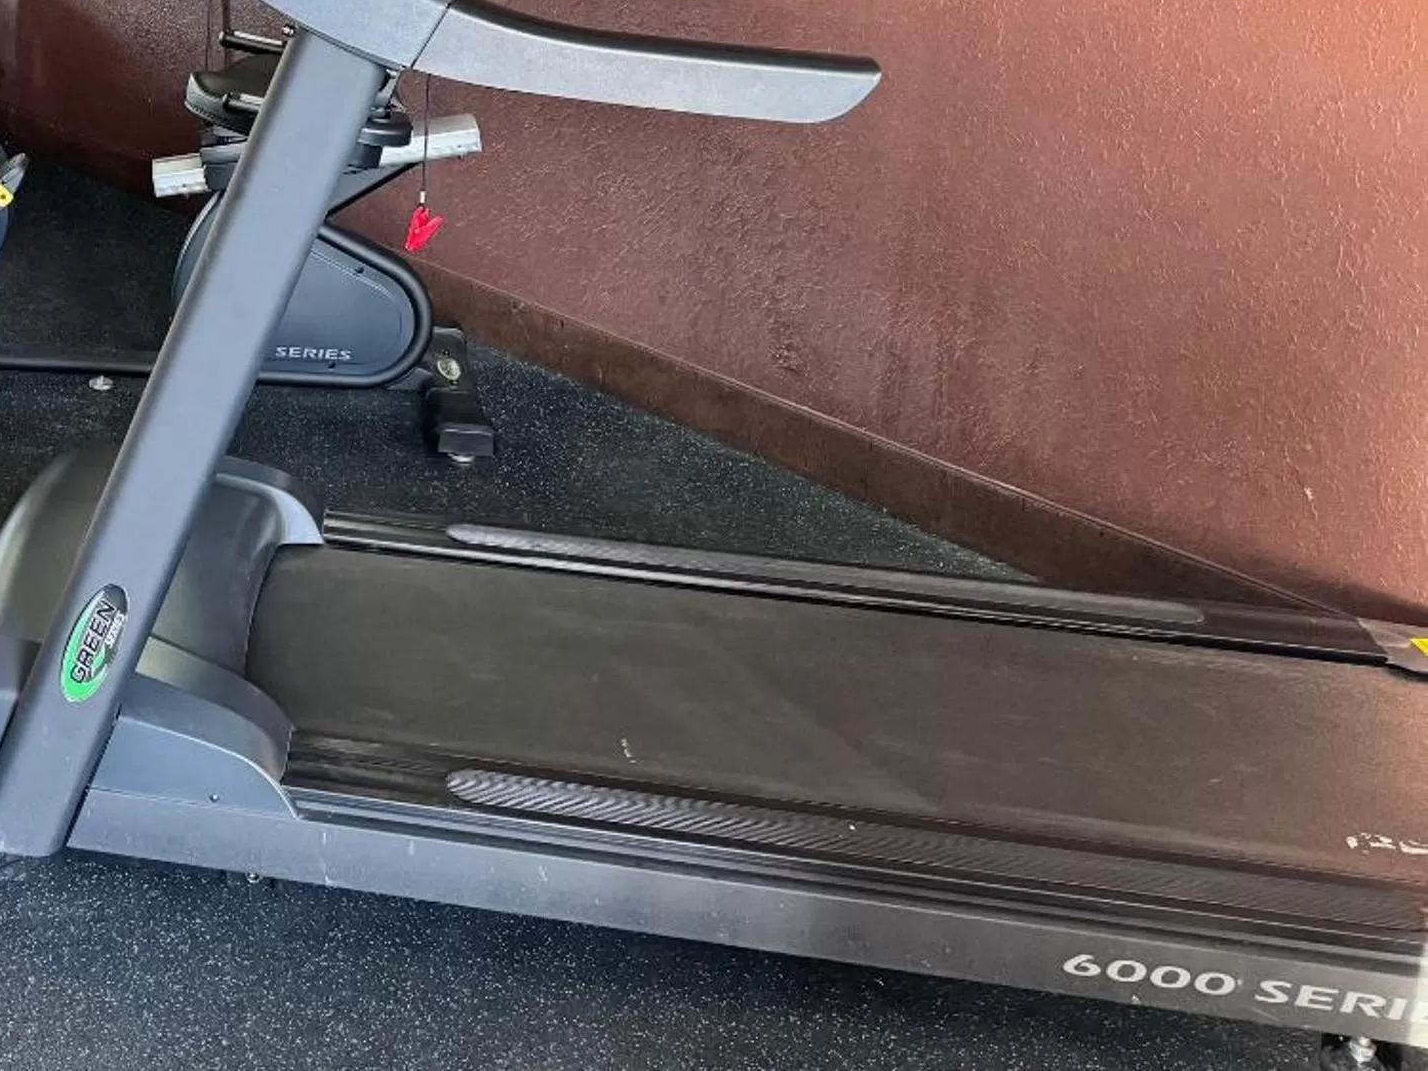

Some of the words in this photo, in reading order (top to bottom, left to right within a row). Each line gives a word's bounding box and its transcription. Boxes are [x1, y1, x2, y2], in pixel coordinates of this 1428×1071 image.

[275, 346, 352, 361] SERIES
[70, 599, 116, 684] GREEN
[1062, 953, 1237, 996] 6000
